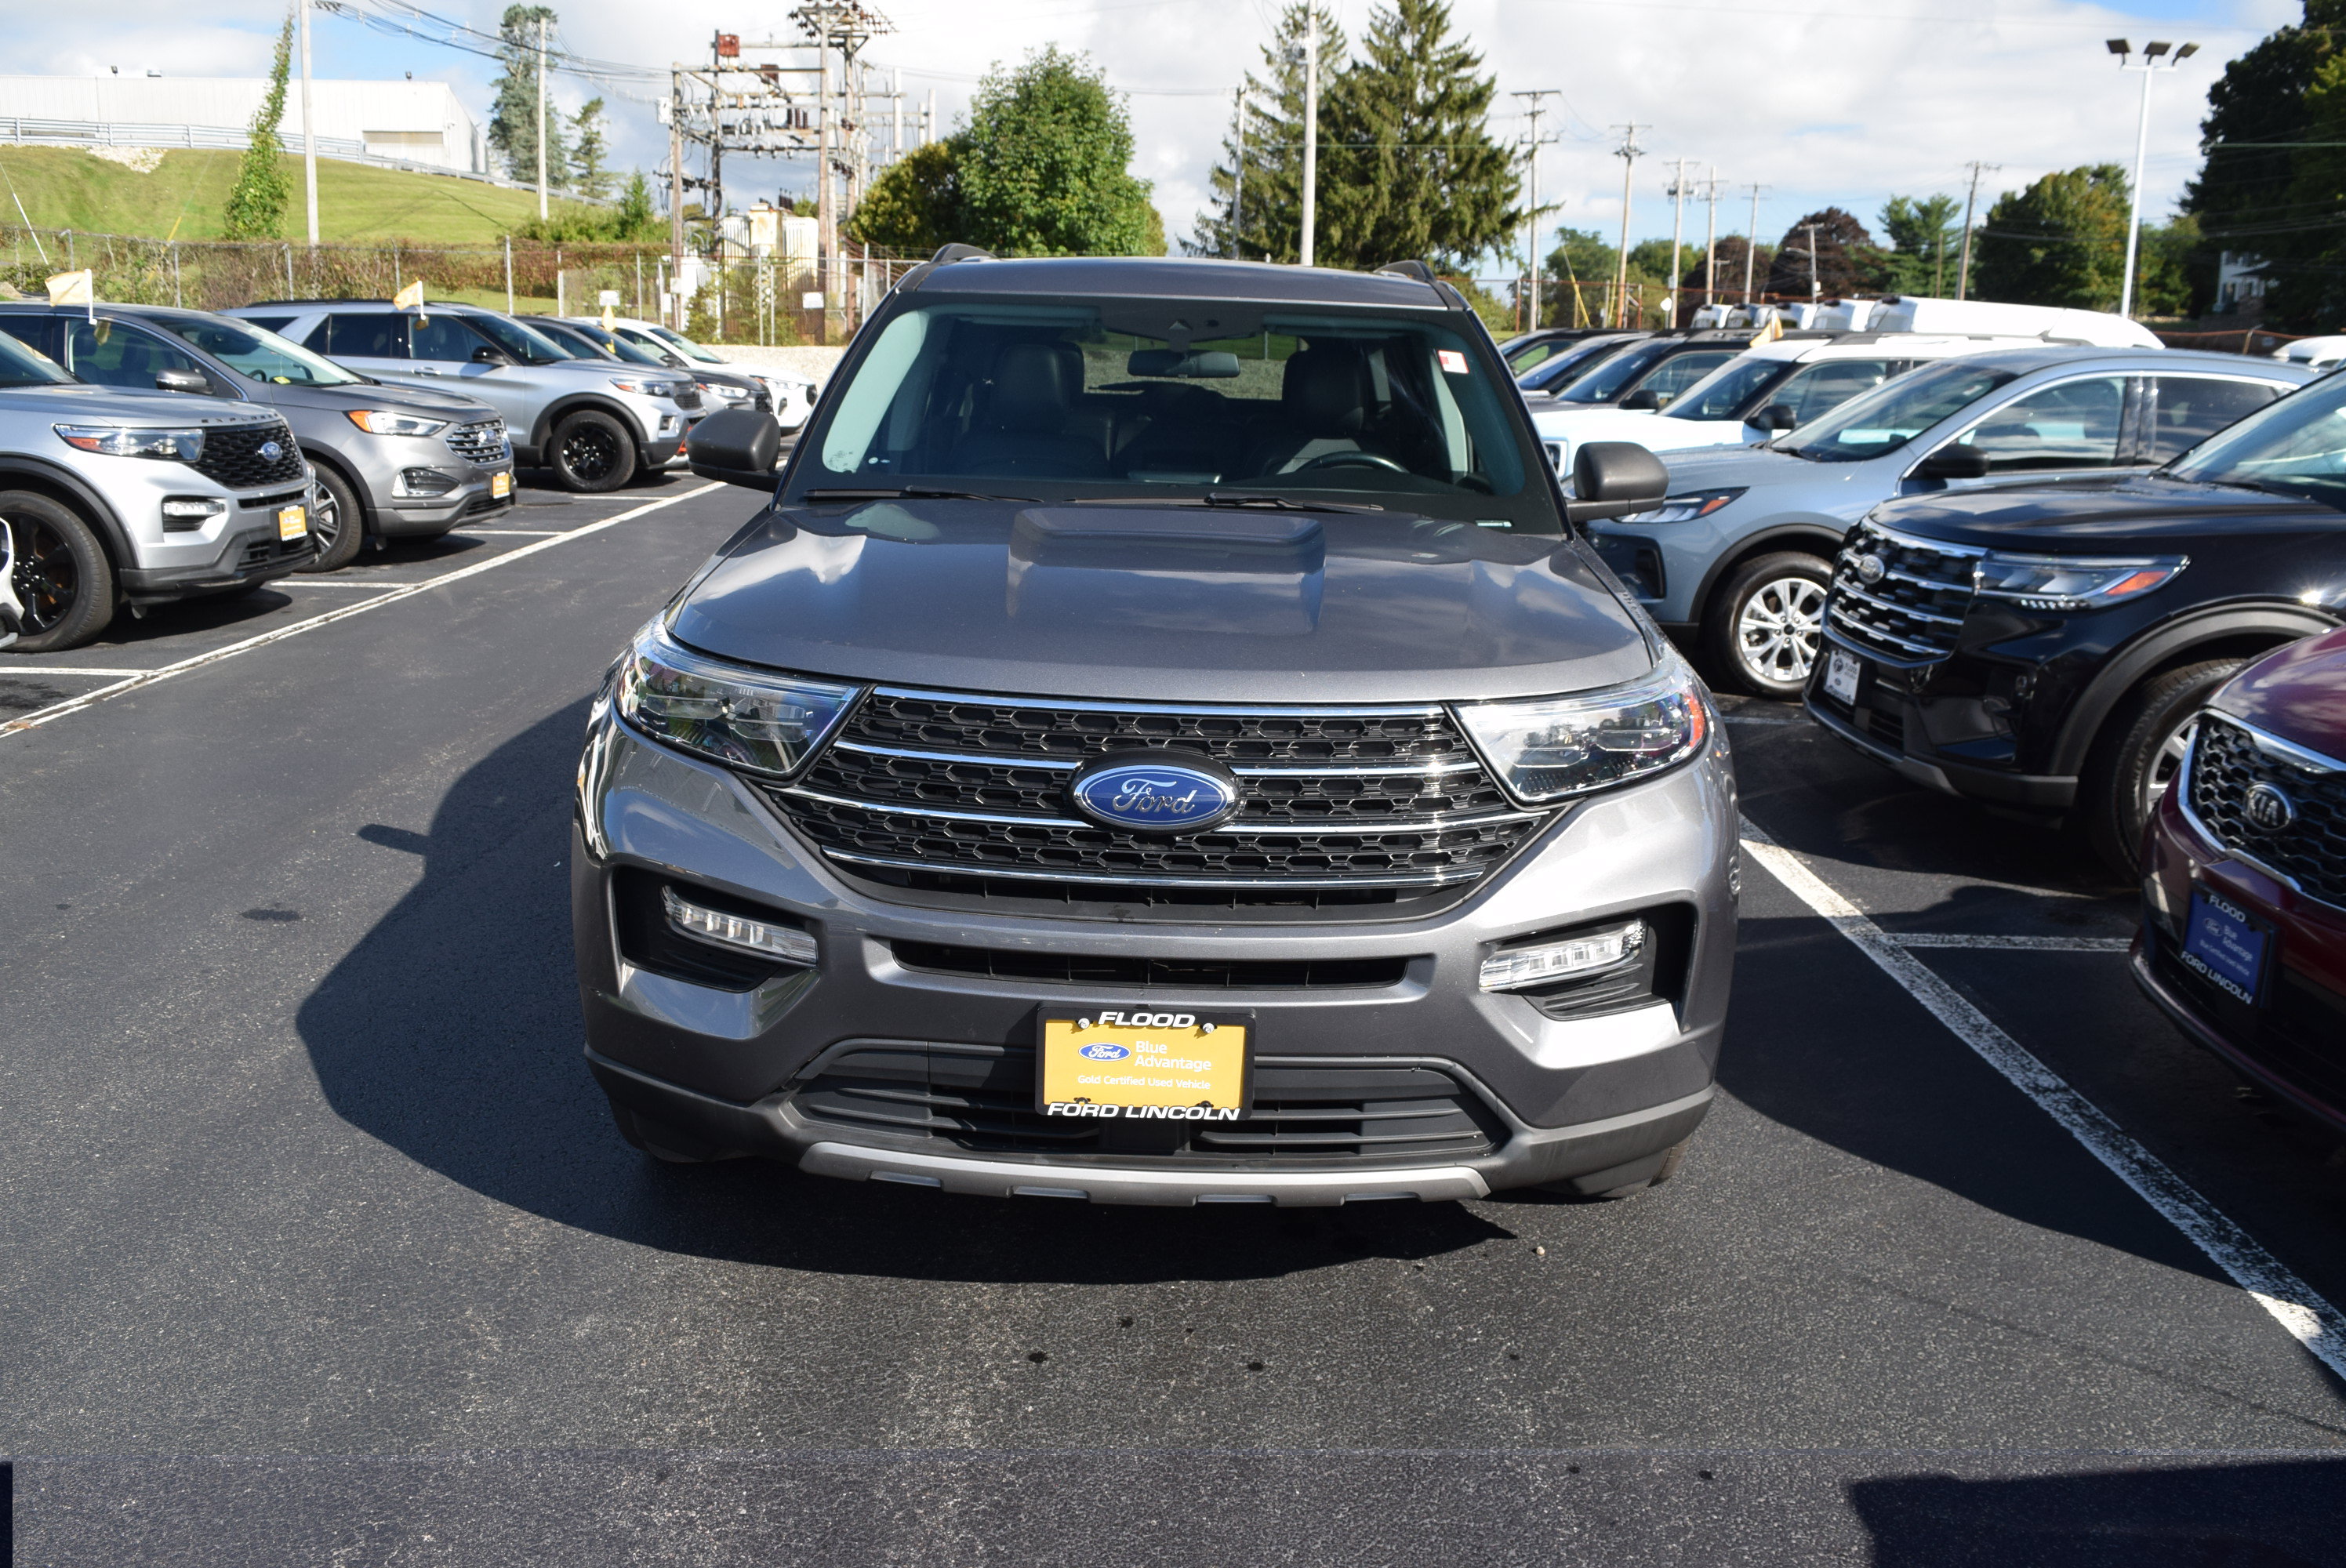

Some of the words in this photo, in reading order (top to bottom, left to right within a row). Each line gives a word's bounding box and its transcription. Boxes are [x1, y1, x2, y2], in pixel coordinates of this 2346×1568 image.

[1113, 778, 1197, 814] Ford
[2247, 792, 2279, 826] KIA
[2209, 895, 2246, 923] FLOOD
[2181, 950, 2207, 974] FORD
[2207, 969, 2253, 1004] LINCOLN
[1098, 1011, 1196, 1028] FLOOD
[1088, 1045, 1120, 1059] Ford
[1135, 1041, 1168, 1054] Blue
[1135, 1055, 1212, 1072] Advantage
[1077, 1075, 1101, 1084] Gold
[1103, 1076, 1145, 1086] Certified
[1148, 1078, 1173, 1087] Used
[1176, 1079, 1211, 1090] Vehicle
[1047, 1102, 1120, 1117] FORD
[1124, 1105, 1240, 1120] LINCOLN
